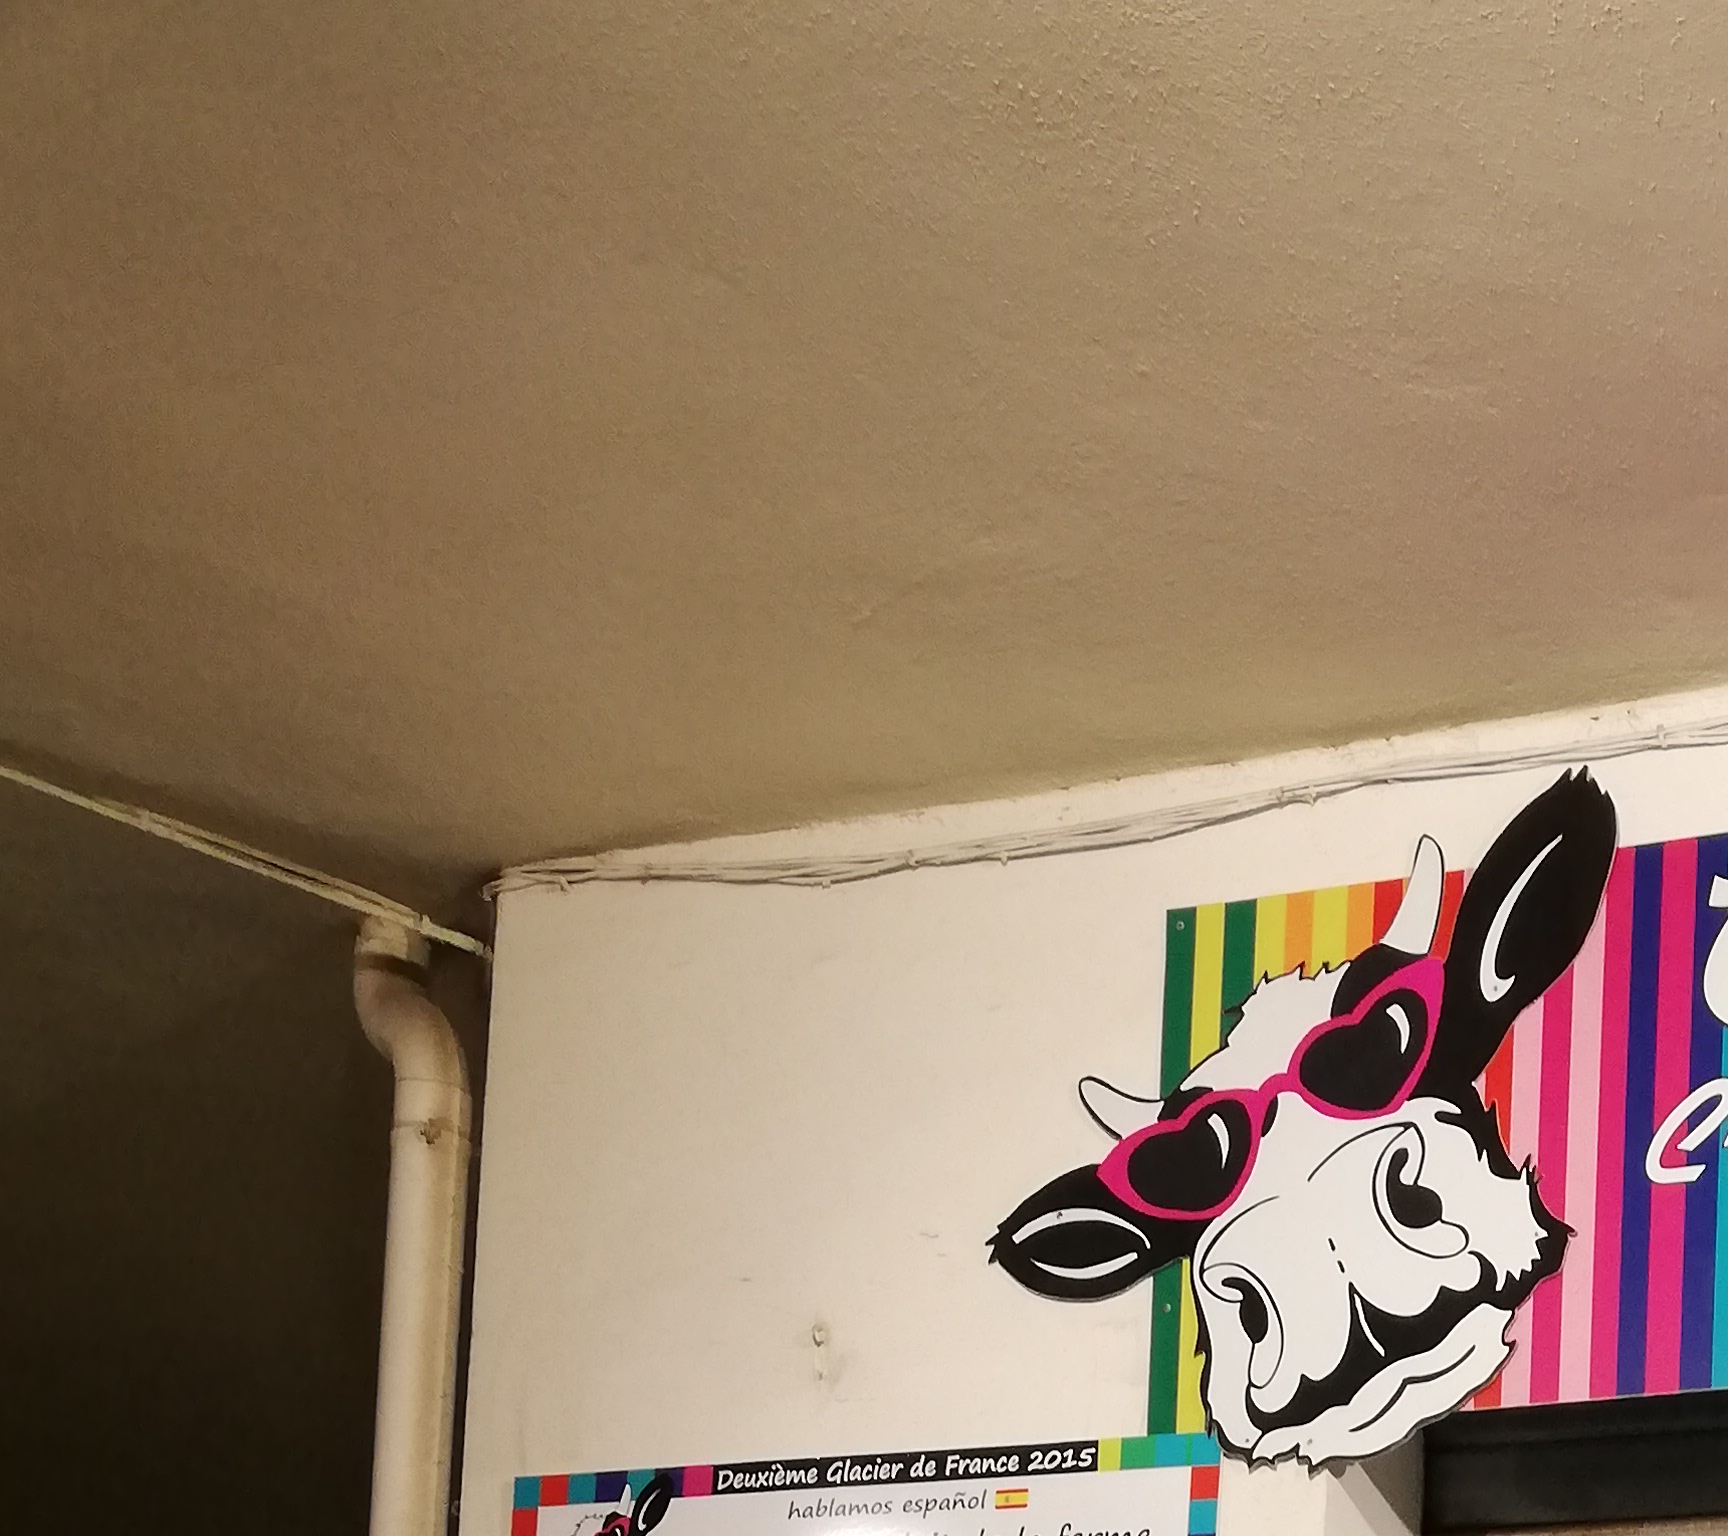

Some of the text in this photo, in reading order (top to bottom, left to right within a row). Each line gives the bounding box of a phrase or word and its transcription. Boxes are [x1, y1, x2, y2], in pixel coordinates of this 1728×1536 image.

[717, 1447, 1095, 1491] Deuxième Glacier de France 2015
[787, 1488, 988, 1521] hablamos español
